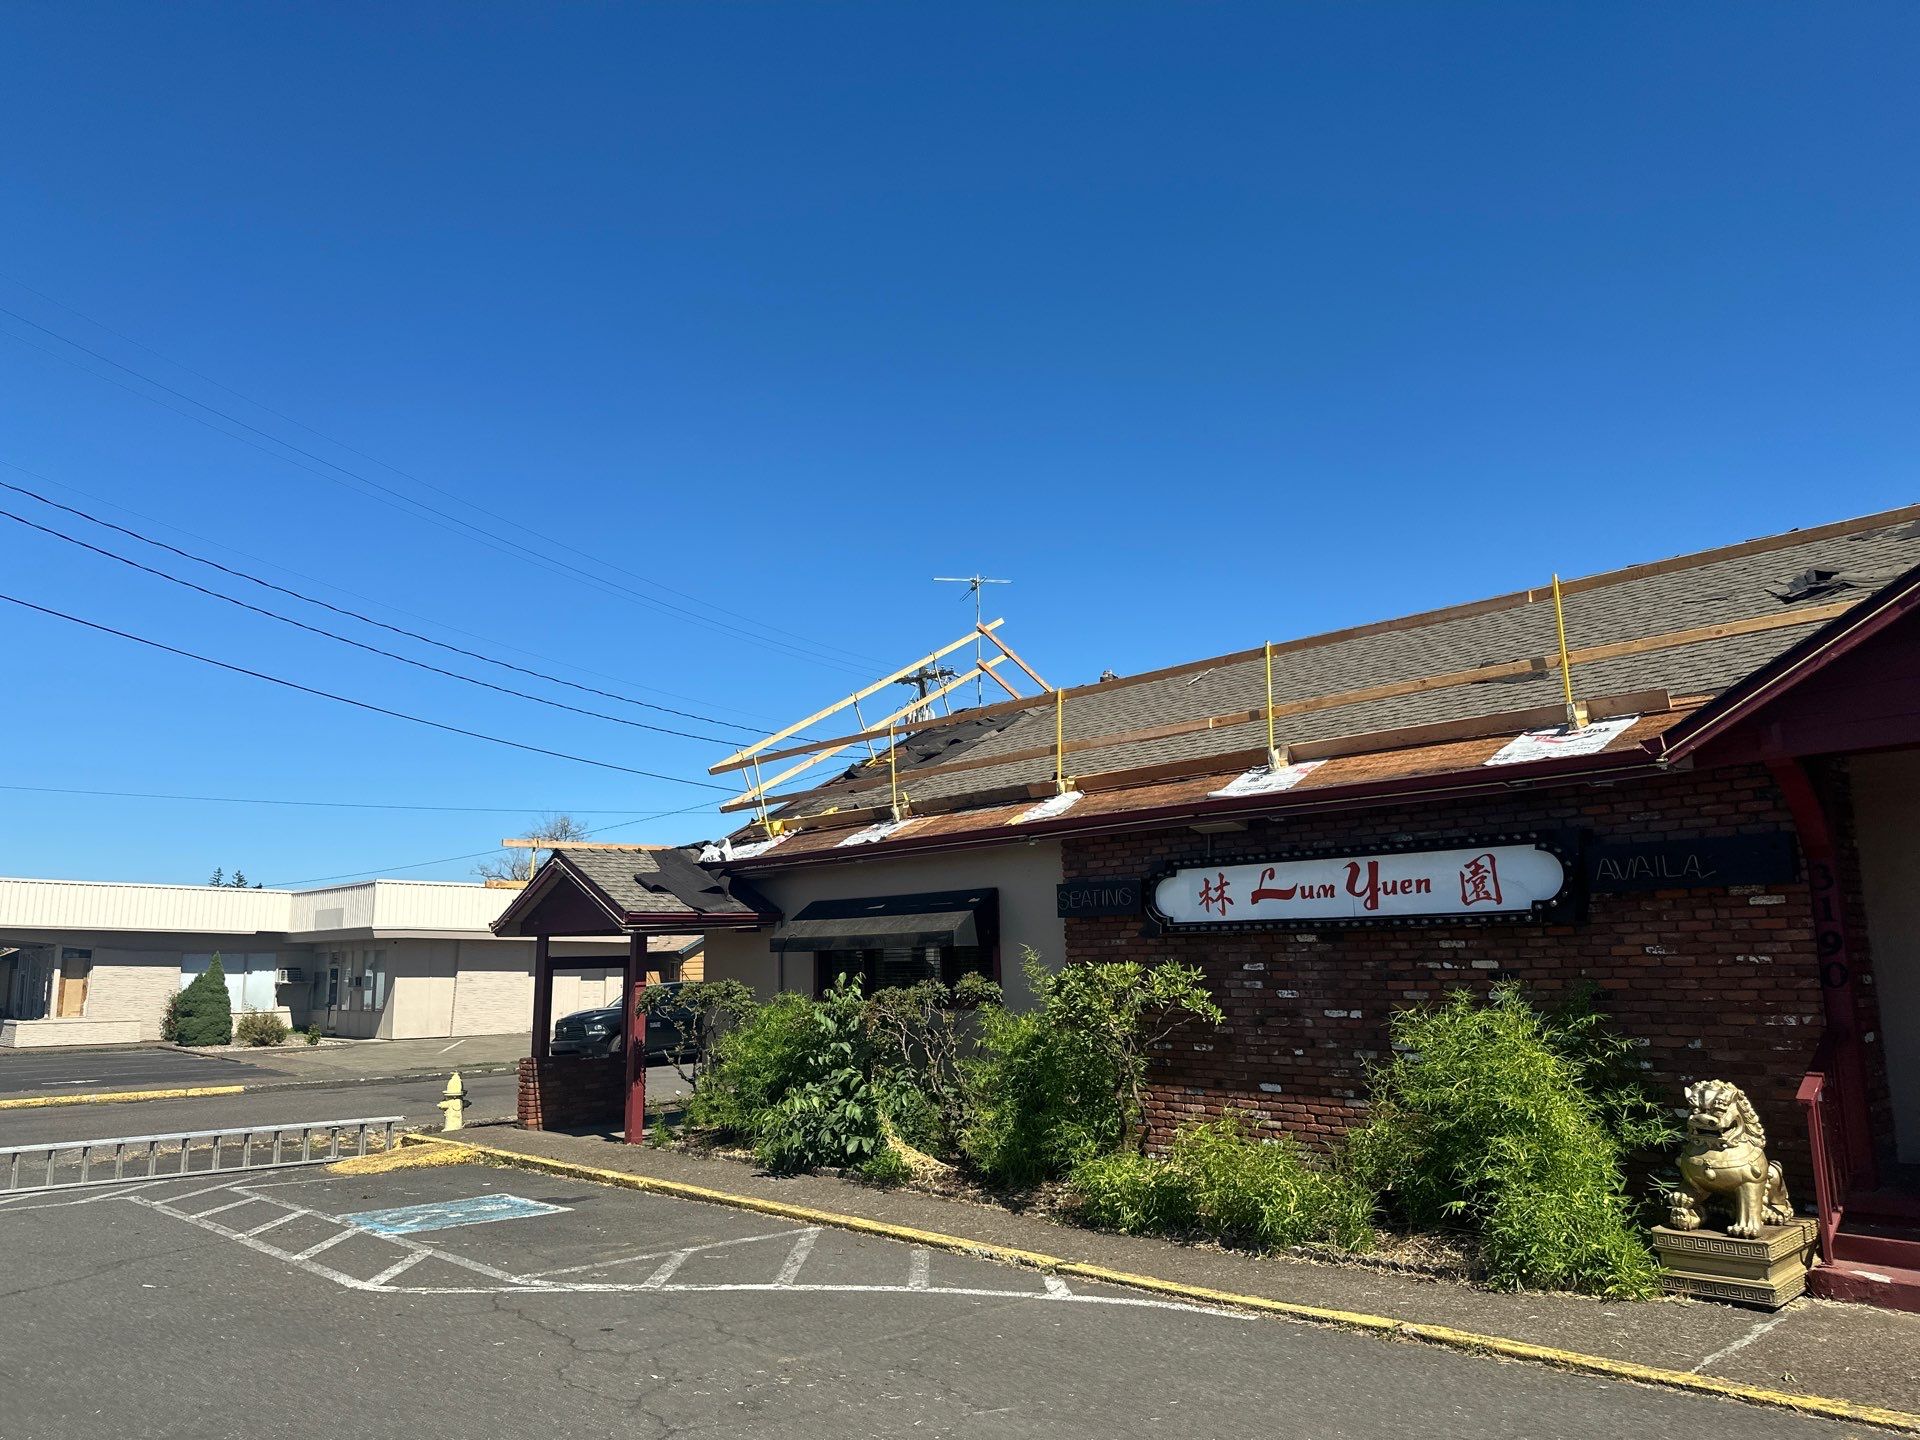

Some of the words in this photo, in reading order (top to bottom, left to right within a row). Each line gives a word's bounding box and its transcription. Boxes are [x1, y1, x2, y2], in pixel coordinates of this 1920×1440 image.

[1343, 861, 1431, 910] Yuen
[1459, 854, 1502, 906] 園
[1596, 855, 1717, 880] AVAILA
[1058, 887, 1132, 910] SEATING
[1199, 872, 1234, 916] 林
[1812, 864, 1848, 988] 3190
